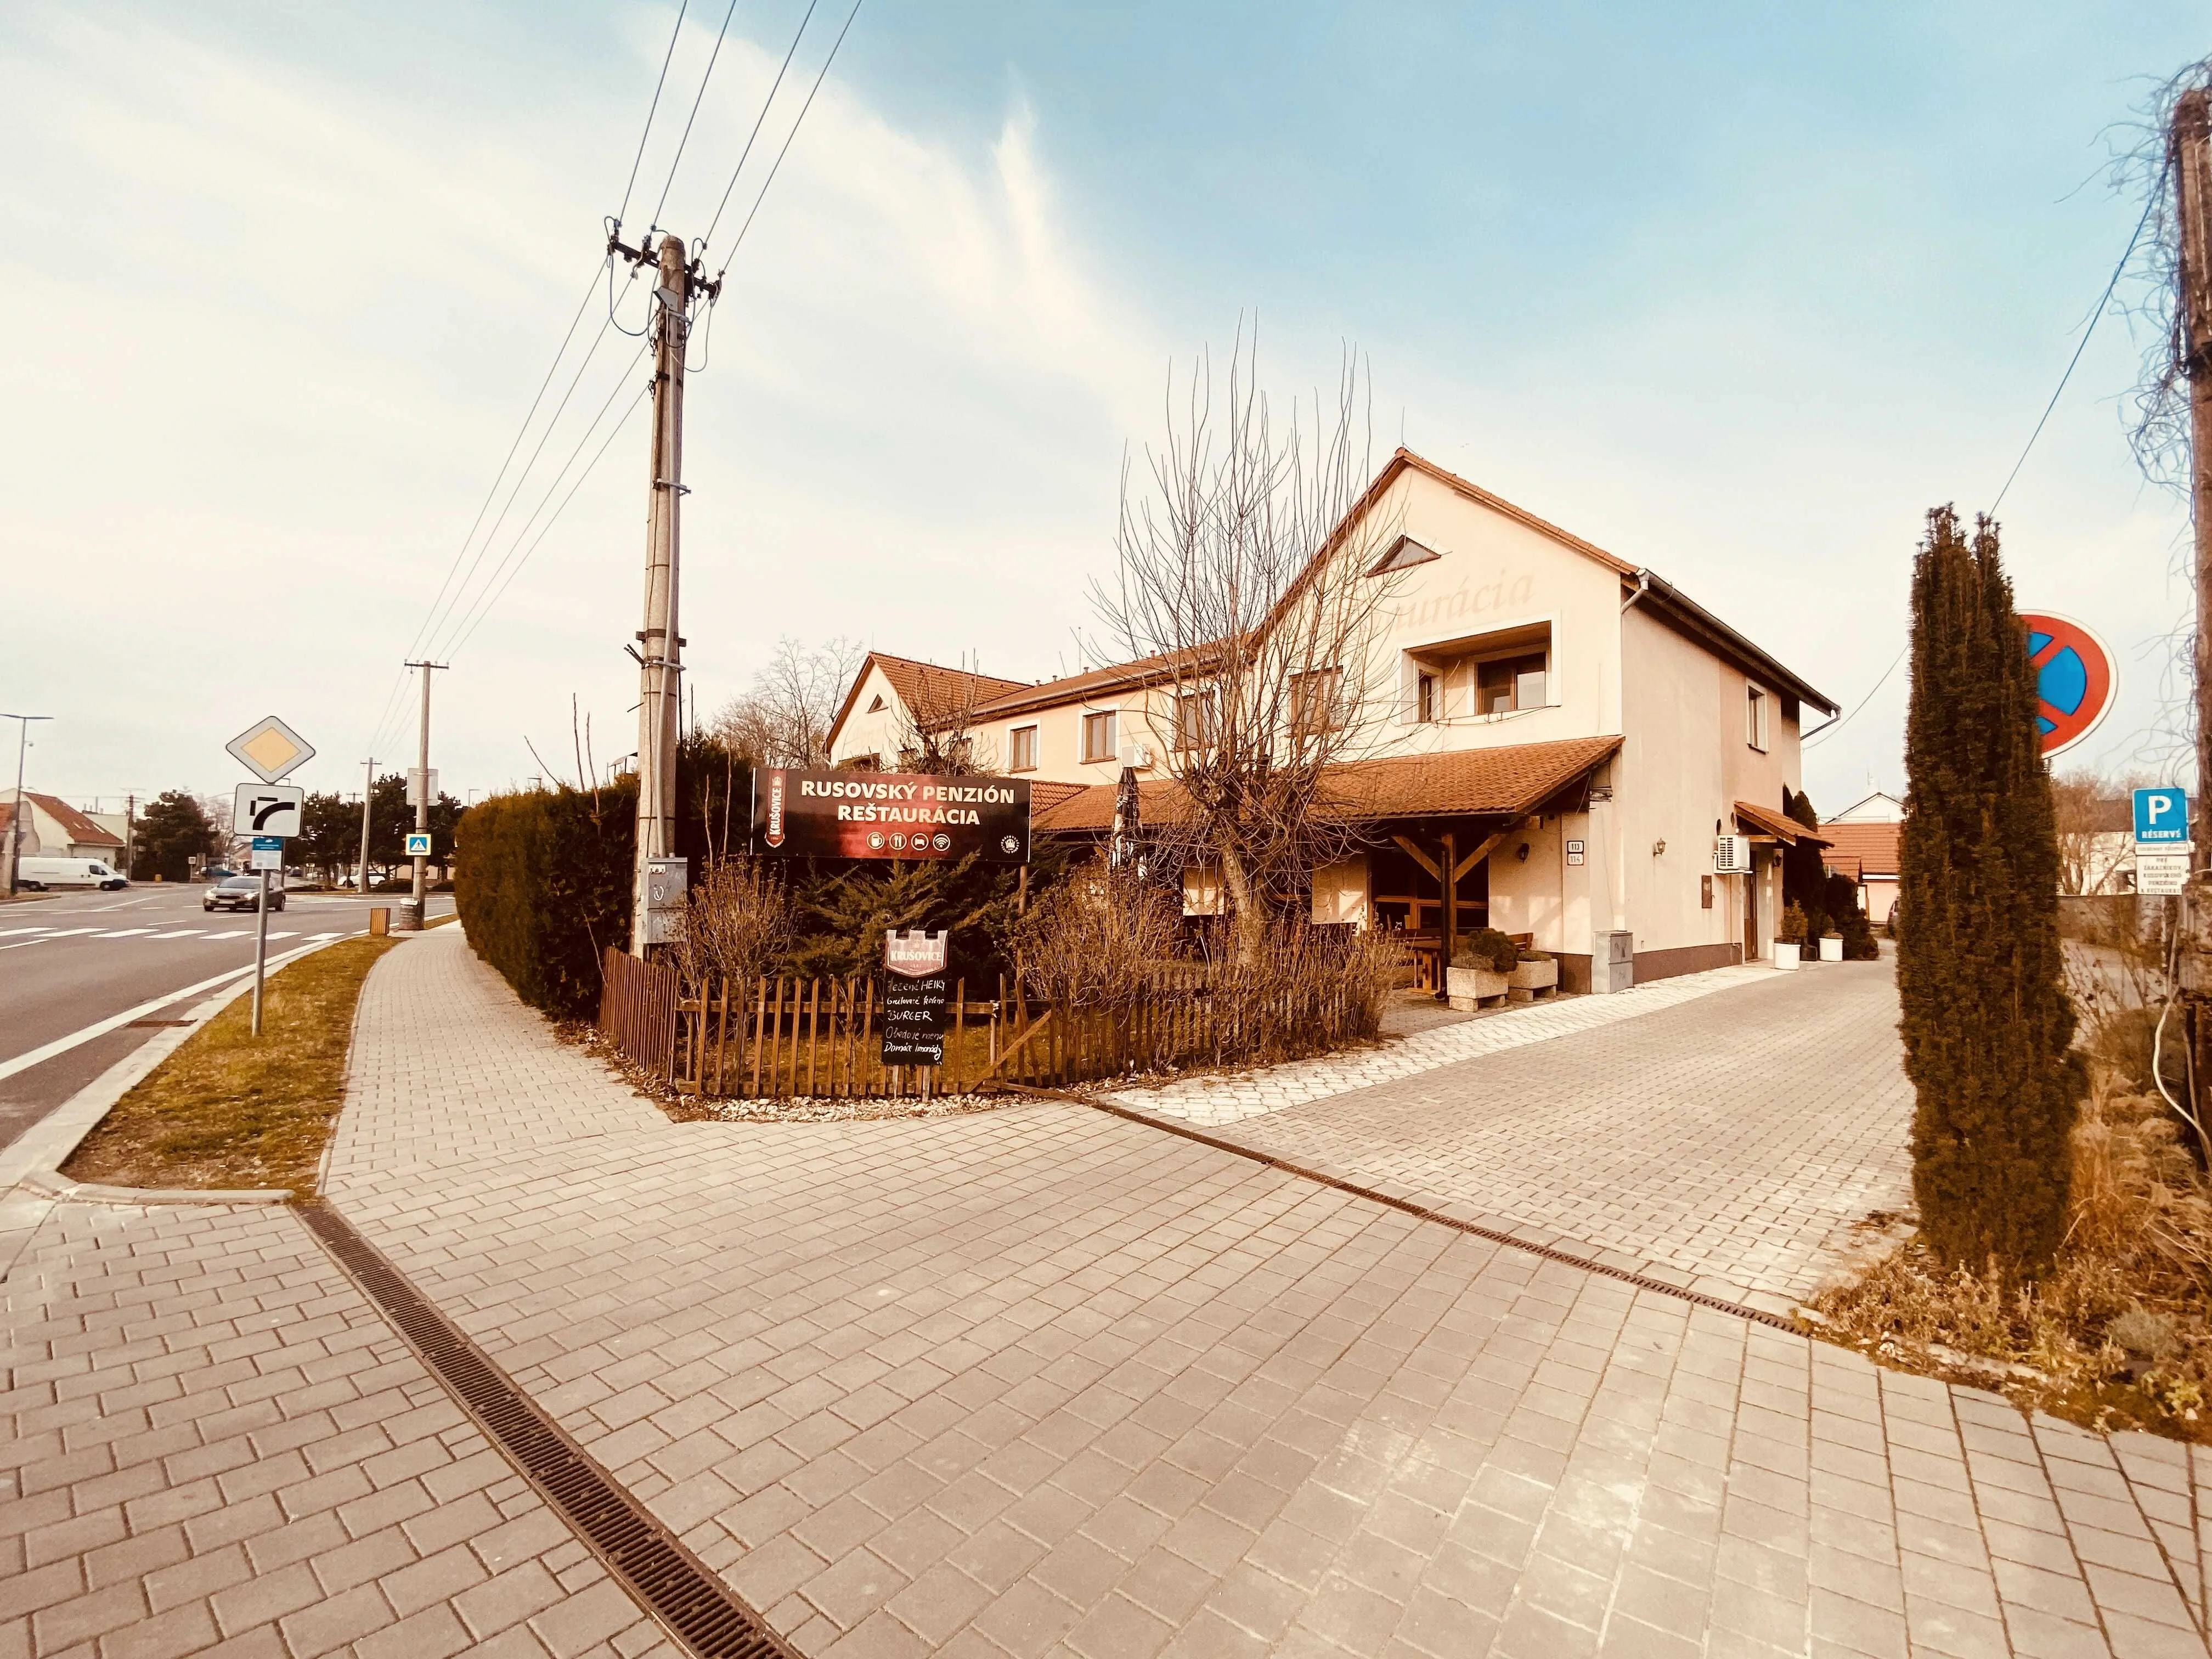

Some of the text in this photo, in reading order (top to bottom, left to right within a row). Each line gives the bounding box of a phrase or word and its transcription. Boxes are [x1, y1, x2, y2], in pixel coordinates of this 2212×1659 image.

[801, 780, 1015, 804] RUSOVSKÝ PENZIÓN
[769, 787, 782, 835] KRUŠOVICE
[838, 802, 980, 826] REŠTAURÁCIA
[2148, 795, 2172, 825] P
[2141, 828, 2182, 838] RÉSERVÉ
[890, 950, 942, 961] KRUŠOVICE
[887, 1009, 933, 1022] BURGER
